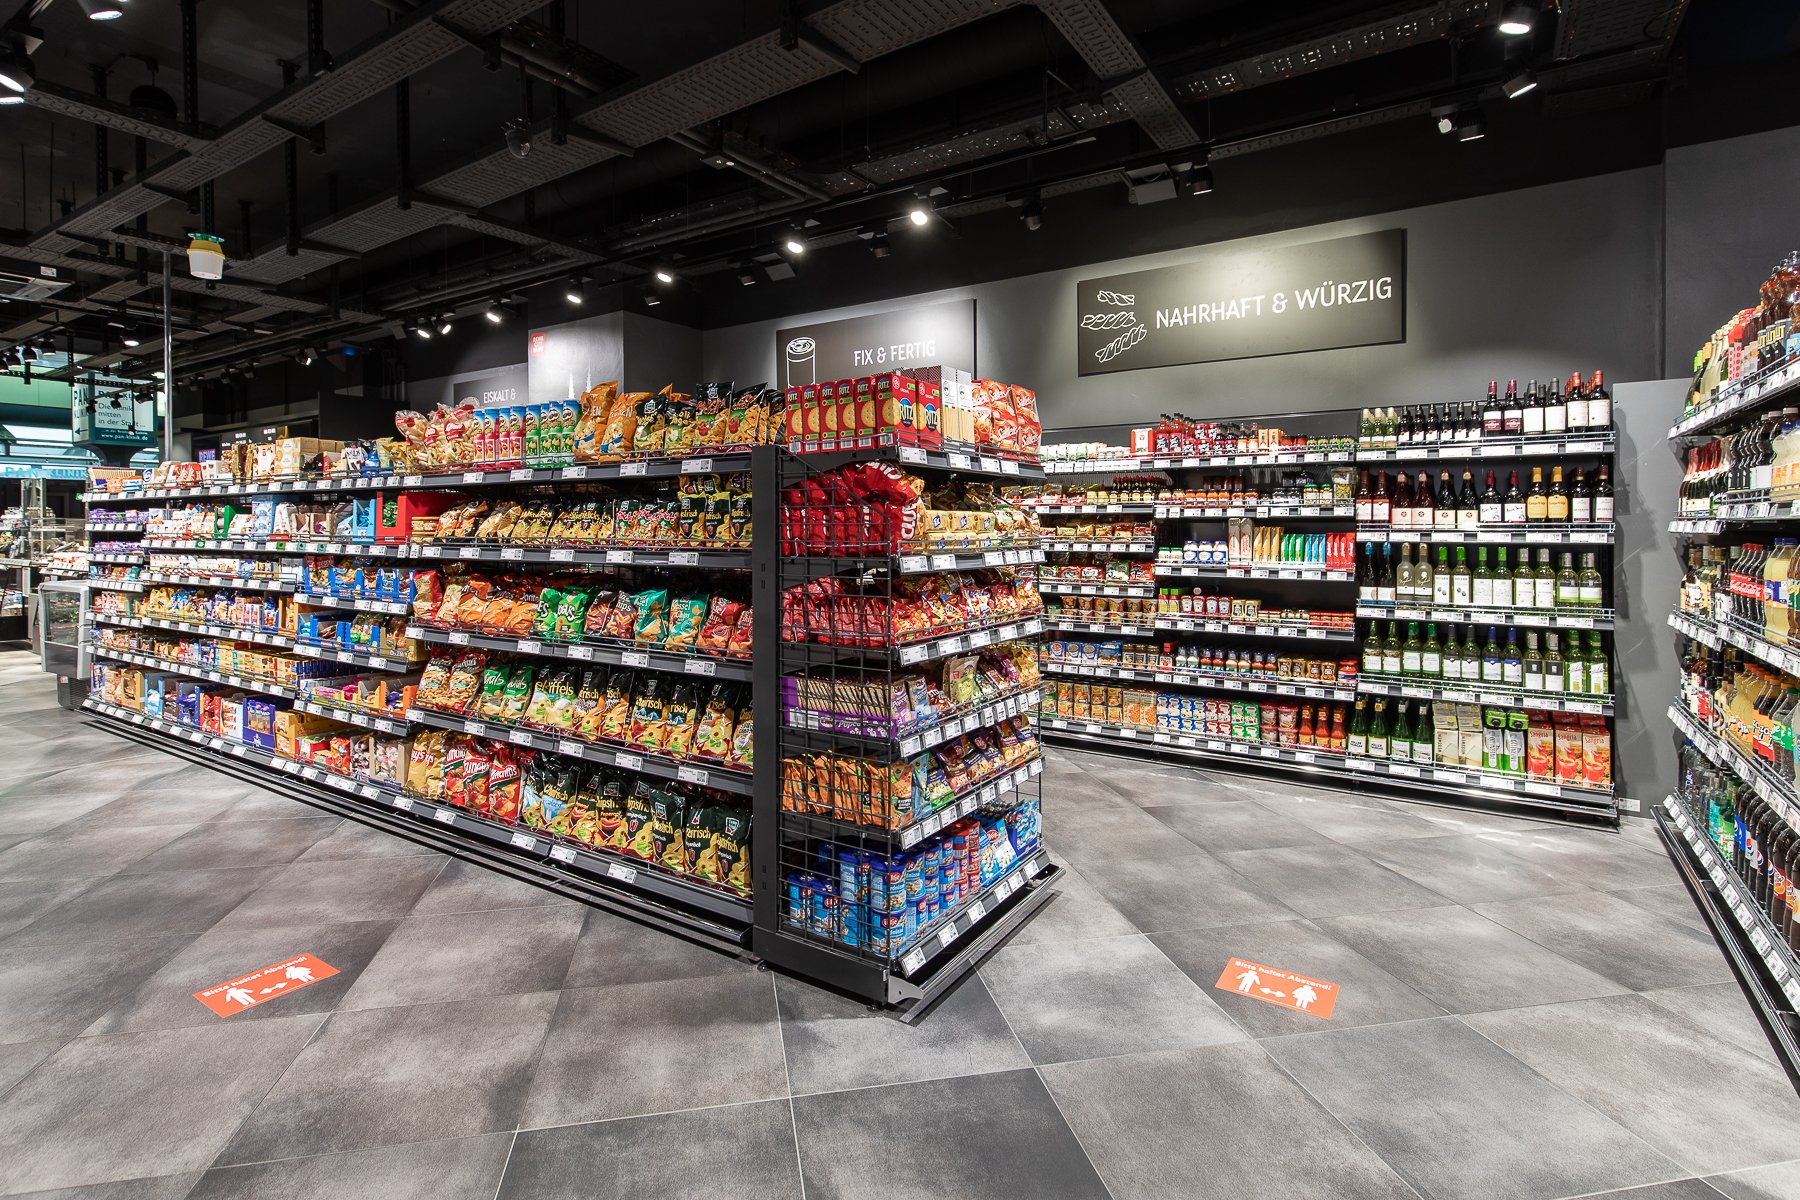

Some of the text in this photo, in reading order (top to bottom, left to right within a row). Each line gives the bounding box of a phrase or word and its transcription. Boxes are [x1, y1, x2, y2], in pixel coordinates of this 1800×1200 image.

[1156, 277, 1392, 328] NAHRHAFT & WÜRZIG
[853, 339, 936, 367] FIX & FERTIG
[838, 386, 850, 395] RITZ
[857, 384, 869, 393] RITZ
[877, 380, 890, 390] RITZ
[483, 388, 516, 404] EISKALT &
[787, 393, 798, 402] RITZ
[804, 391, 815, 399] RITZ
[822, 388, 833, 397] RITZ
[899, 404, 914, 420] RITZ
[925, 409, 939, 425] RITZ
[199, 450, 215, 462] REWE
[5, 466, 87, 478] PAN KLINIK
[616, 601, 632, 612] hips
[670, 701, 688, 714] risch
[1529, 730, 1549, 739] Sangria
[1557, 733, 1577, 741] Sangria
[1584, 736, 1605, 745] Sangria
[597, 795, 628, 809] hipsfrisch
[202, 956, 308, 997] Bitte haltet Abstand!
[1234, 960, 1333, 991] Bitte haltet Abstand!
